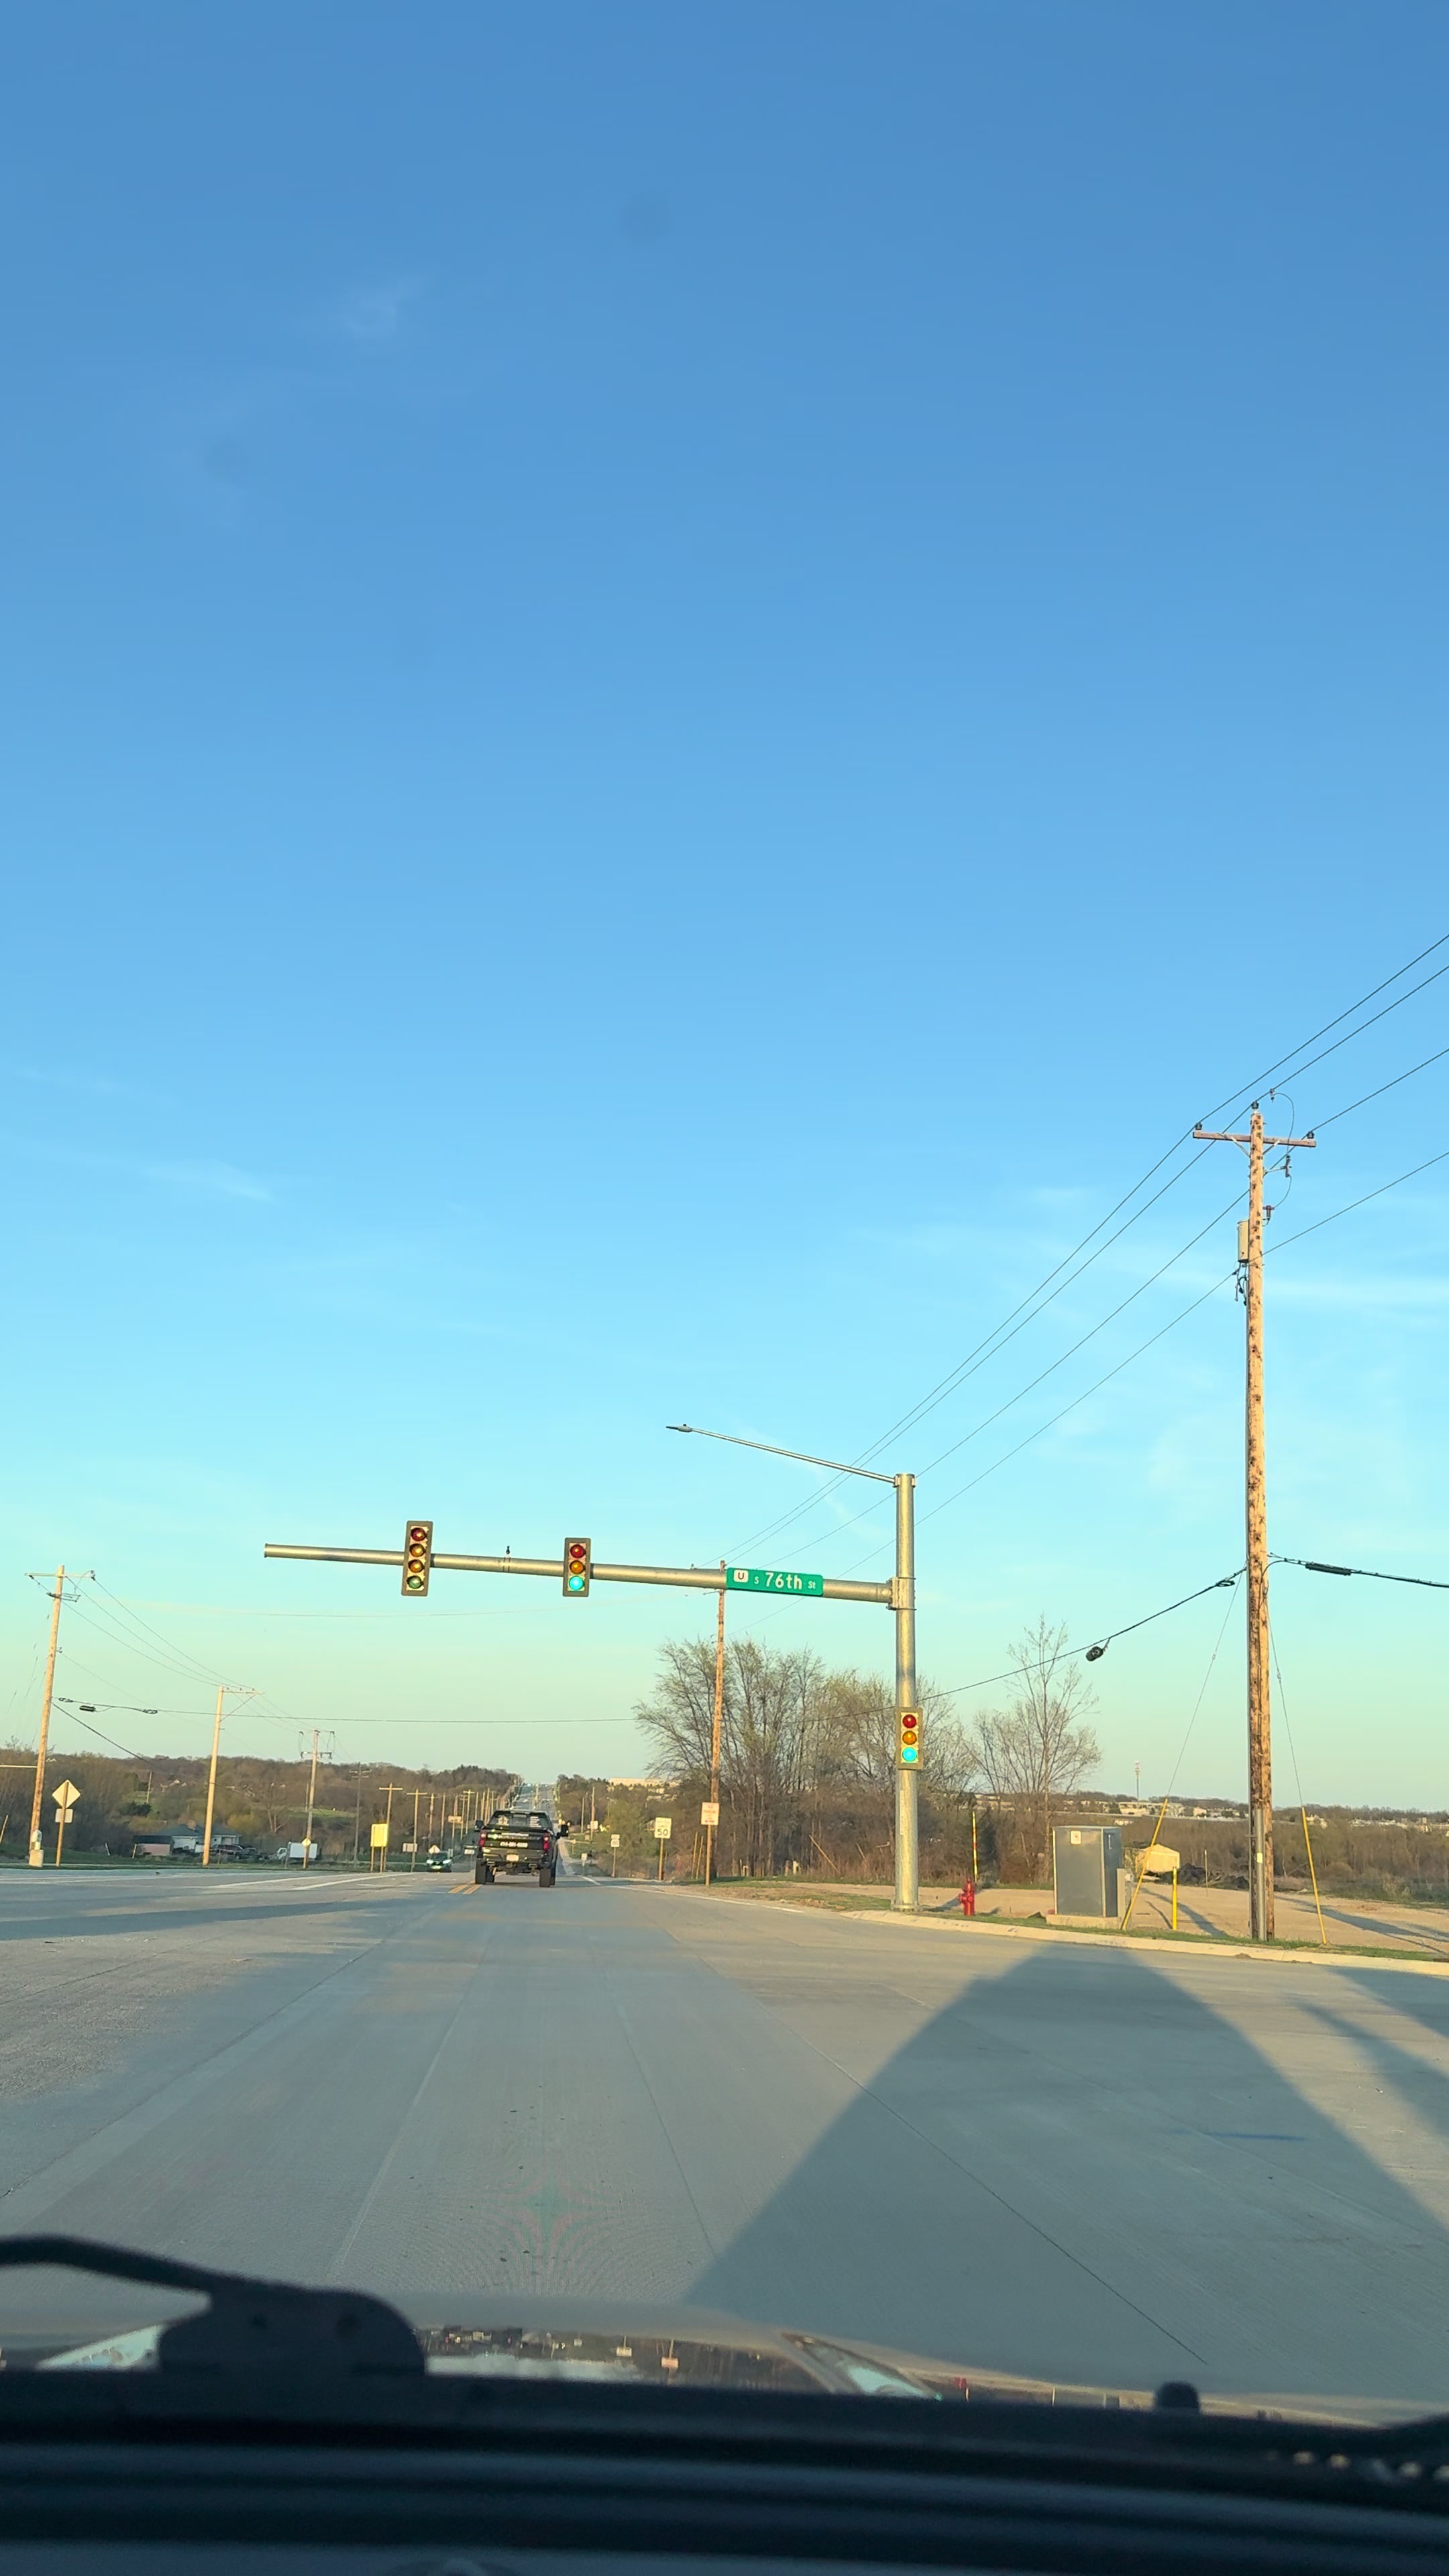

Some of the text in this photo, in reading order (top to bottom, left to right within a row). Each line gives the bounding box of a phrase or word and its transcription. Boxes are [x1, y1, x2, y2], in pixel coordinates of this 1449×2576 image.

[738, 1572, 745, 1580] U
[765, 1572, 802, 1590] 76th
[808, 1580, 816, 1589] St
[657, 1828, 669, 1836] 50
